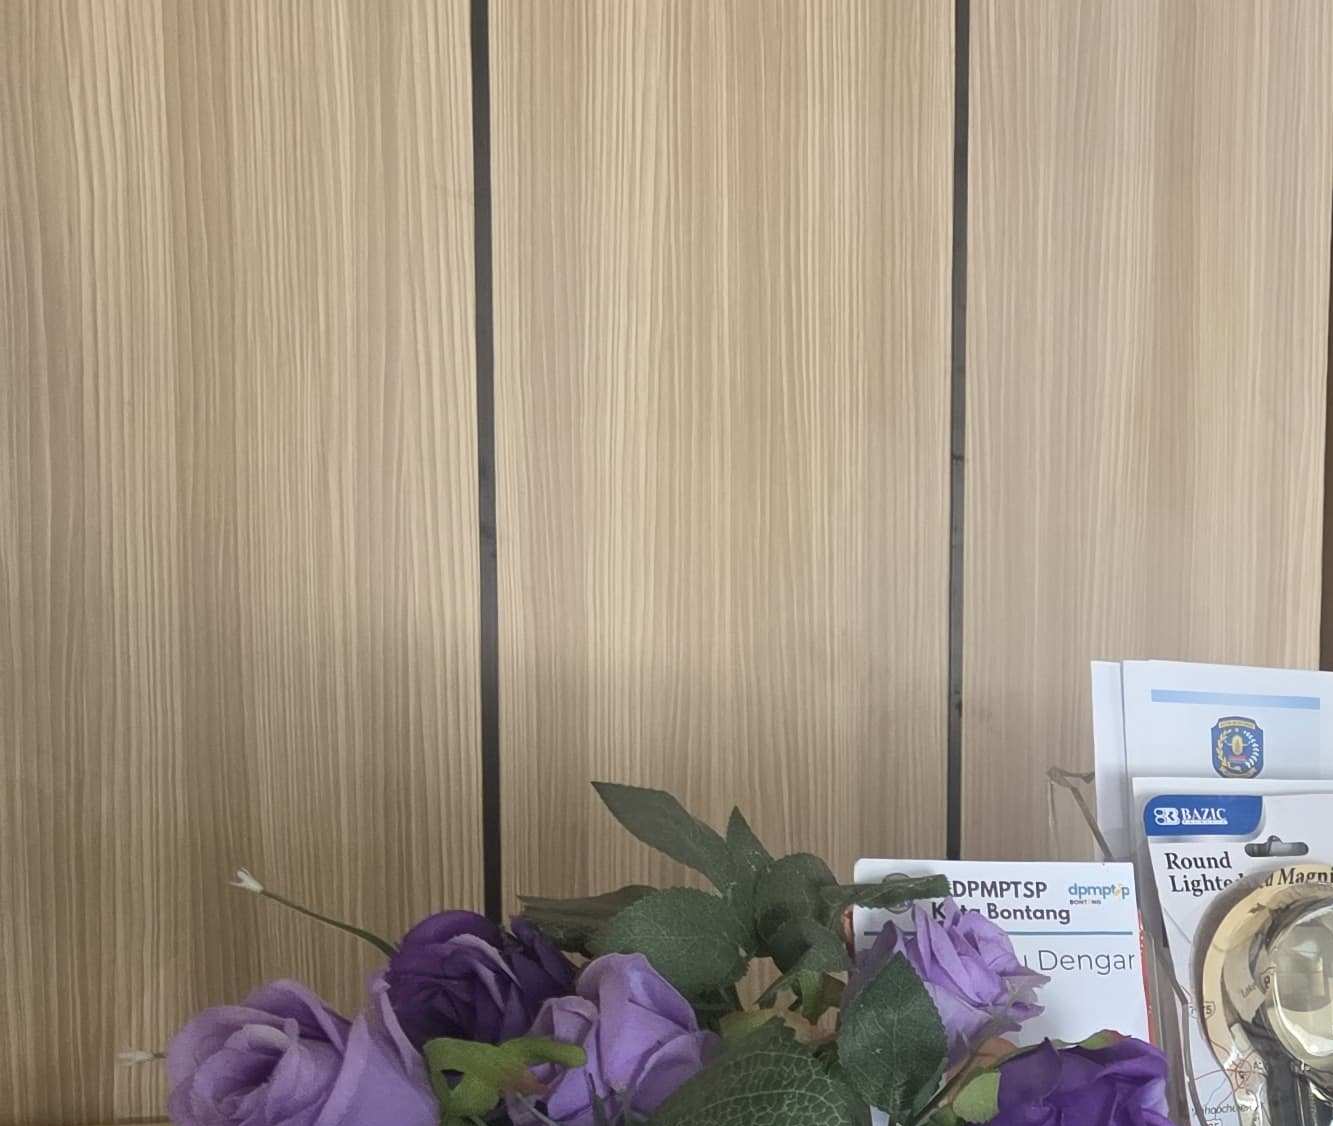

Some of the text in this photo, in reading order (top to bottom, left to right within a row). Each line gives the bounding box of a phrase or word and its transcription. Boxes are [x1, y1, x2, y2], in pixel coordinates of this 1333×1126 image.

[1180, 808, 1226, 820] BAZIC
[1164, 851, 1232, 870] Round
[953, 880, 1048, 898] DPMPTSP
[987, 903, 1071, 925] Bontang
[1038, 950, 1136, 976] Dengar
